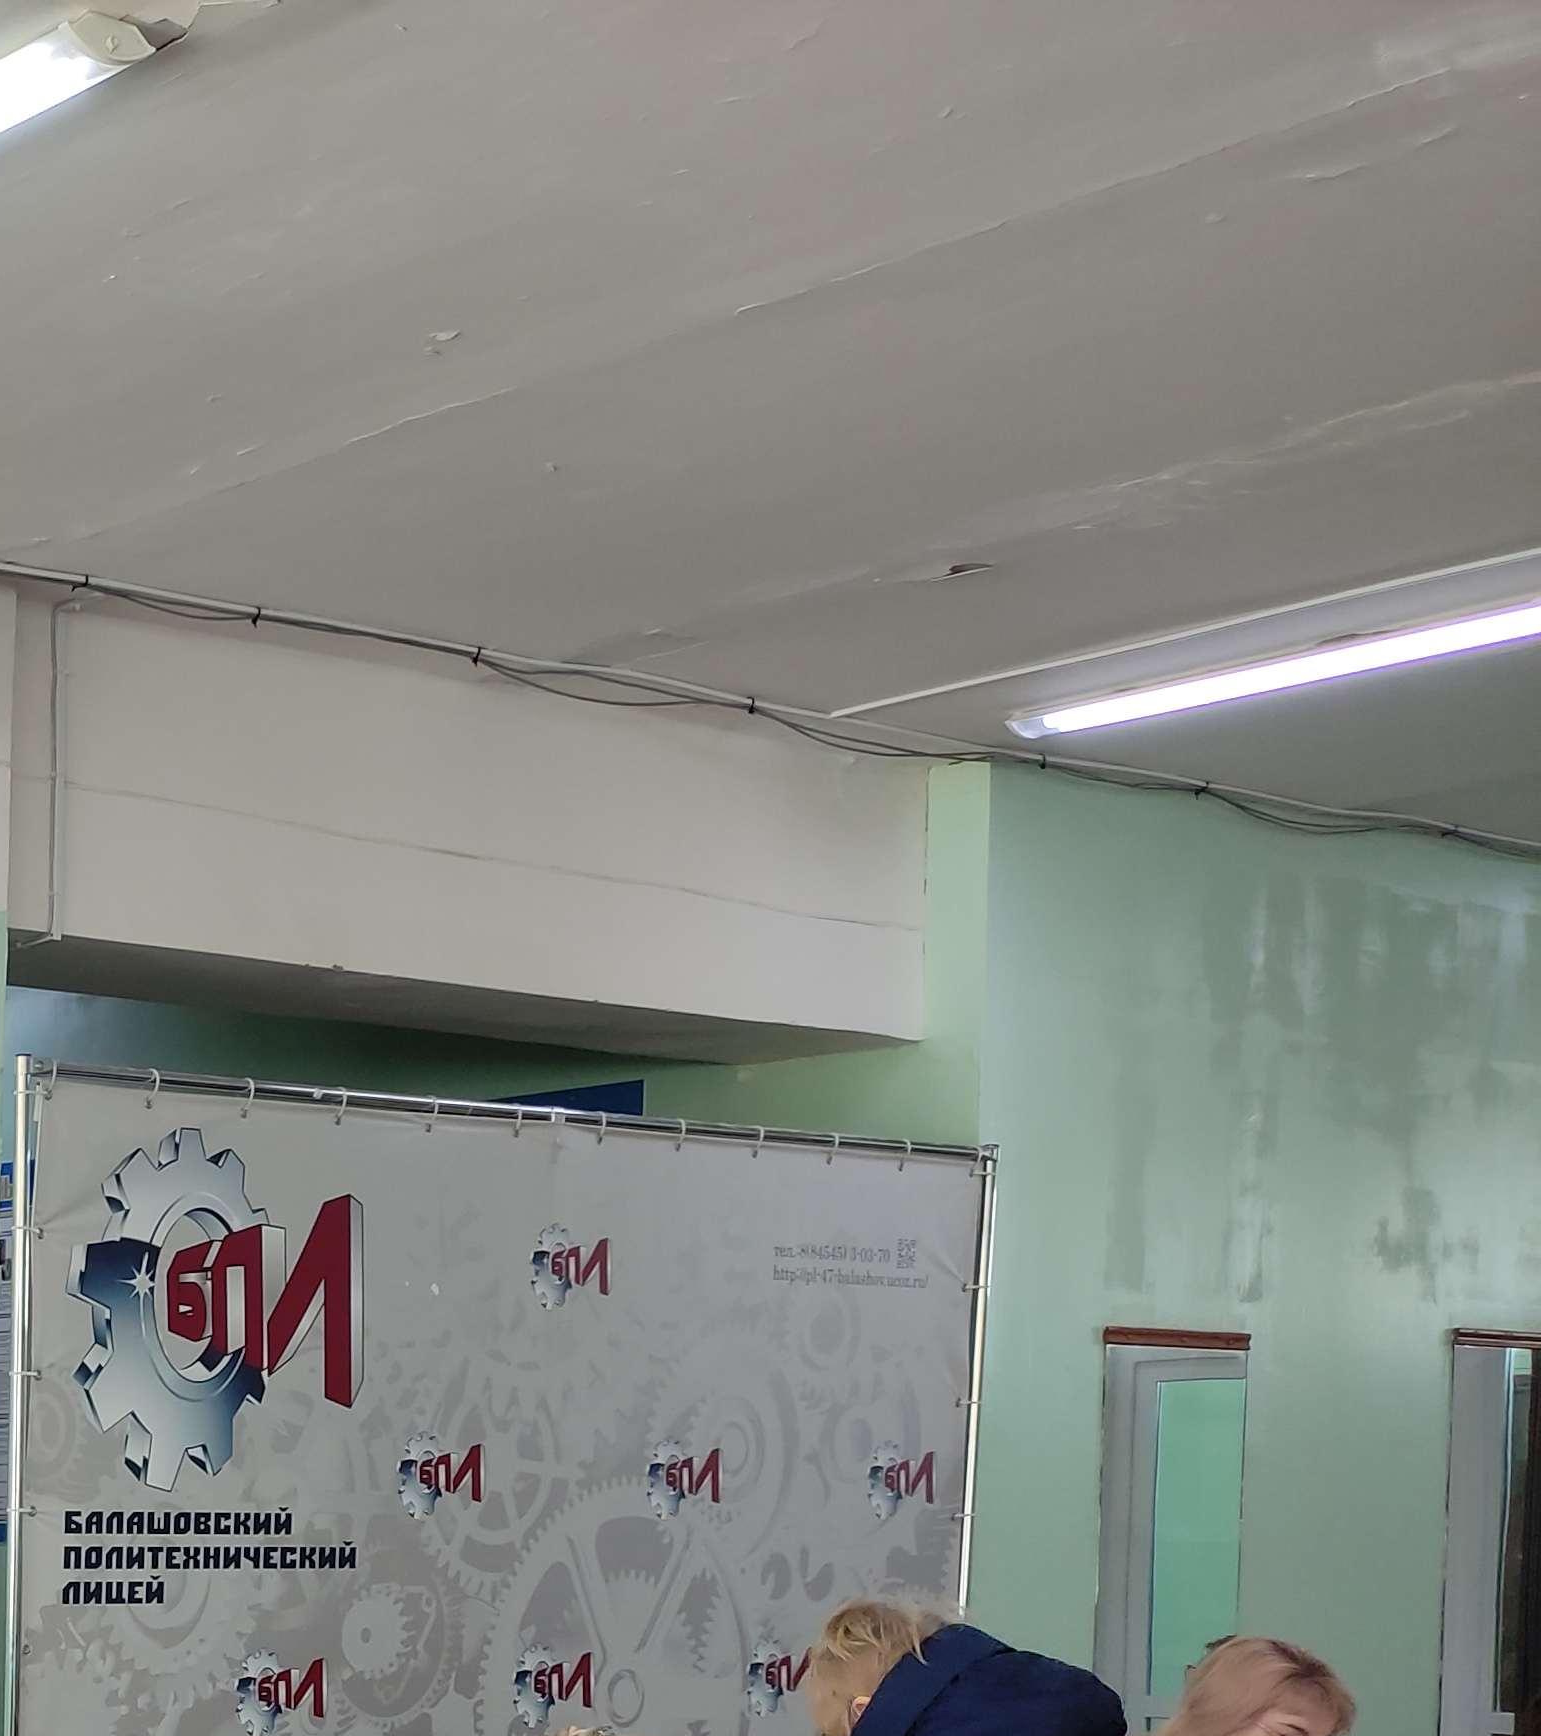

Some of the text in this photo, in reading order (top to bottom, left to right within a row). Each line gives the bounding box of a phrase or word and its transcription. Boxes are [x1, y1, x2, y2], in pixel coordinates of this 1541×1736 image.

[64, 1507, 293, 1535] БАЛАШОВСКИЙ
[63, 1541, 357, 1569] ПОЛИТЕХНИЧЕСКИЙ
[62, 1575, 165, 1605] ЛИЦЕЙ
